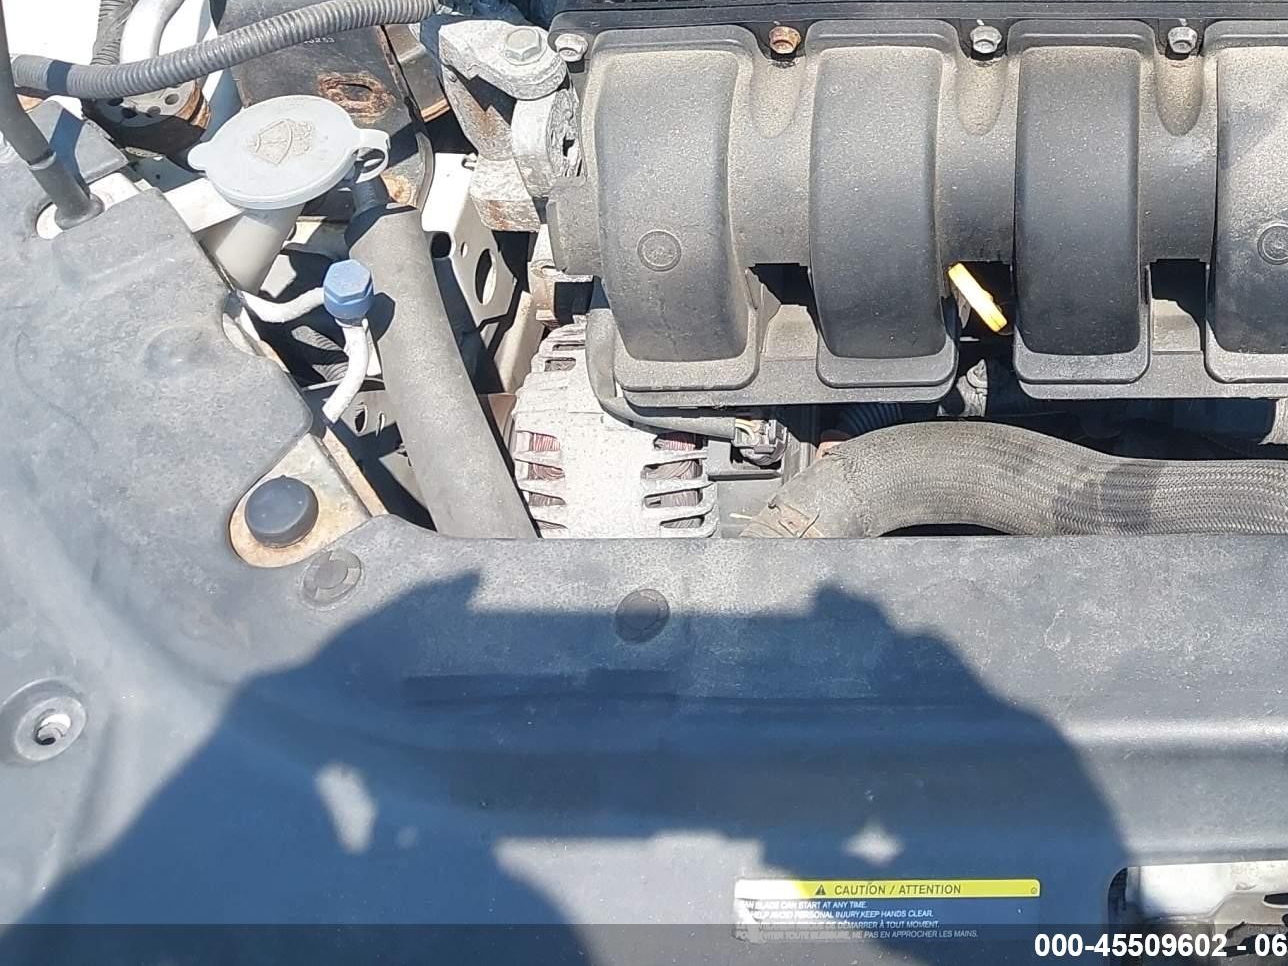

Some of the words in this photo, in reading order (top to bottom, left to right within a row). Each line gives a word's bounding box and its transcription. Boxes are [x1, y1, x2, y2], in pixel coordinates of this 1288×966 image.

[834, 885, 886, 896] CAUTION
[889, 885, 895, 895] /
[900, 885, 961, 895] ATTENTION
[795, 910, 834, 919] PERSONAL
[881, 910, 906, 918] HANDS
[840, 919, 878, 929] DÉMARRER
[879, 918, 885, 928] À
[886, 920, 904, 929] TOUT
[906, 920, 940, 929] MOMENT.
[880, 930, 890, 938] EN
[892, 930, 938, 938] APPROCHER
[939, 930, 953, 938] LES
[954, 929, 979, 938] MAINS.
